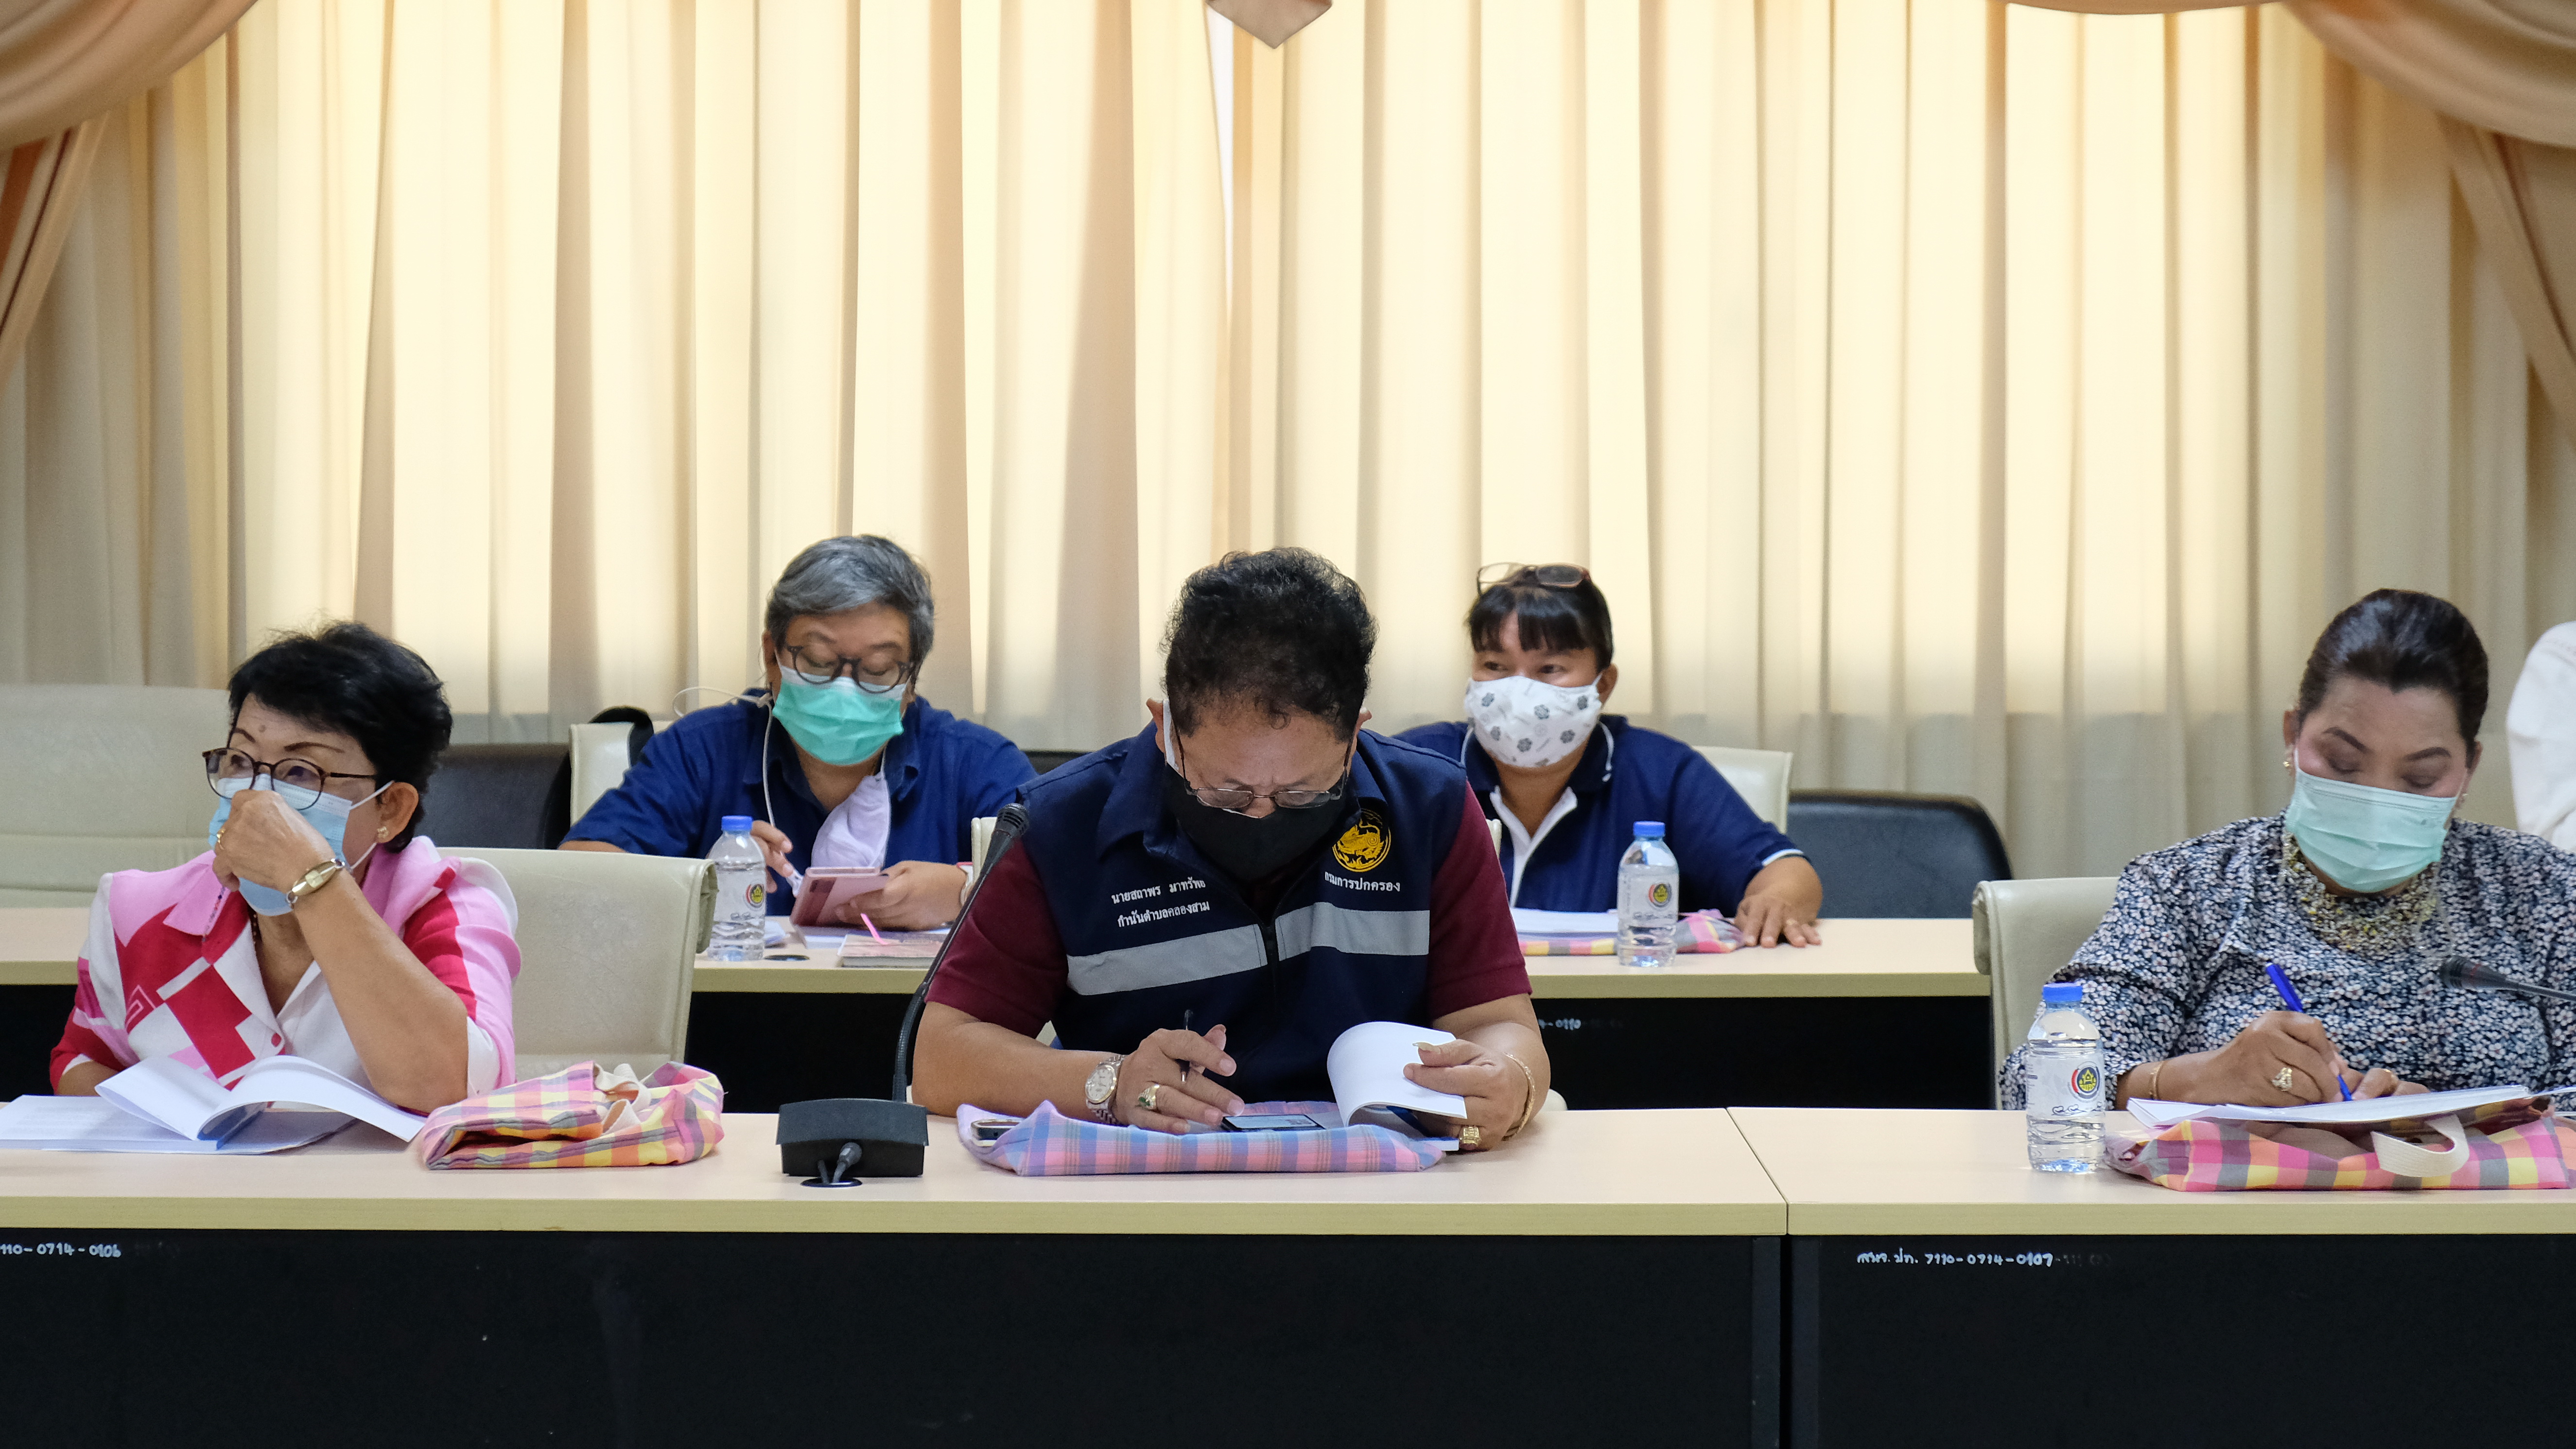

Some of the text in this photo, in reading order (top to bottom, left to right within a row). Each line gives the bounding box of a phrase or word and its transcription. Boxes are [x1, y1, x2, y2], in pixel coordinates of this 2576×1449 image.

[1324, 871, 1400, 892] กรมการปกครอง
[1111, 886, 1161, 904] นายสถาพร
[1117, 901, 1210, 927] กำนันตำบลคลองสาม
